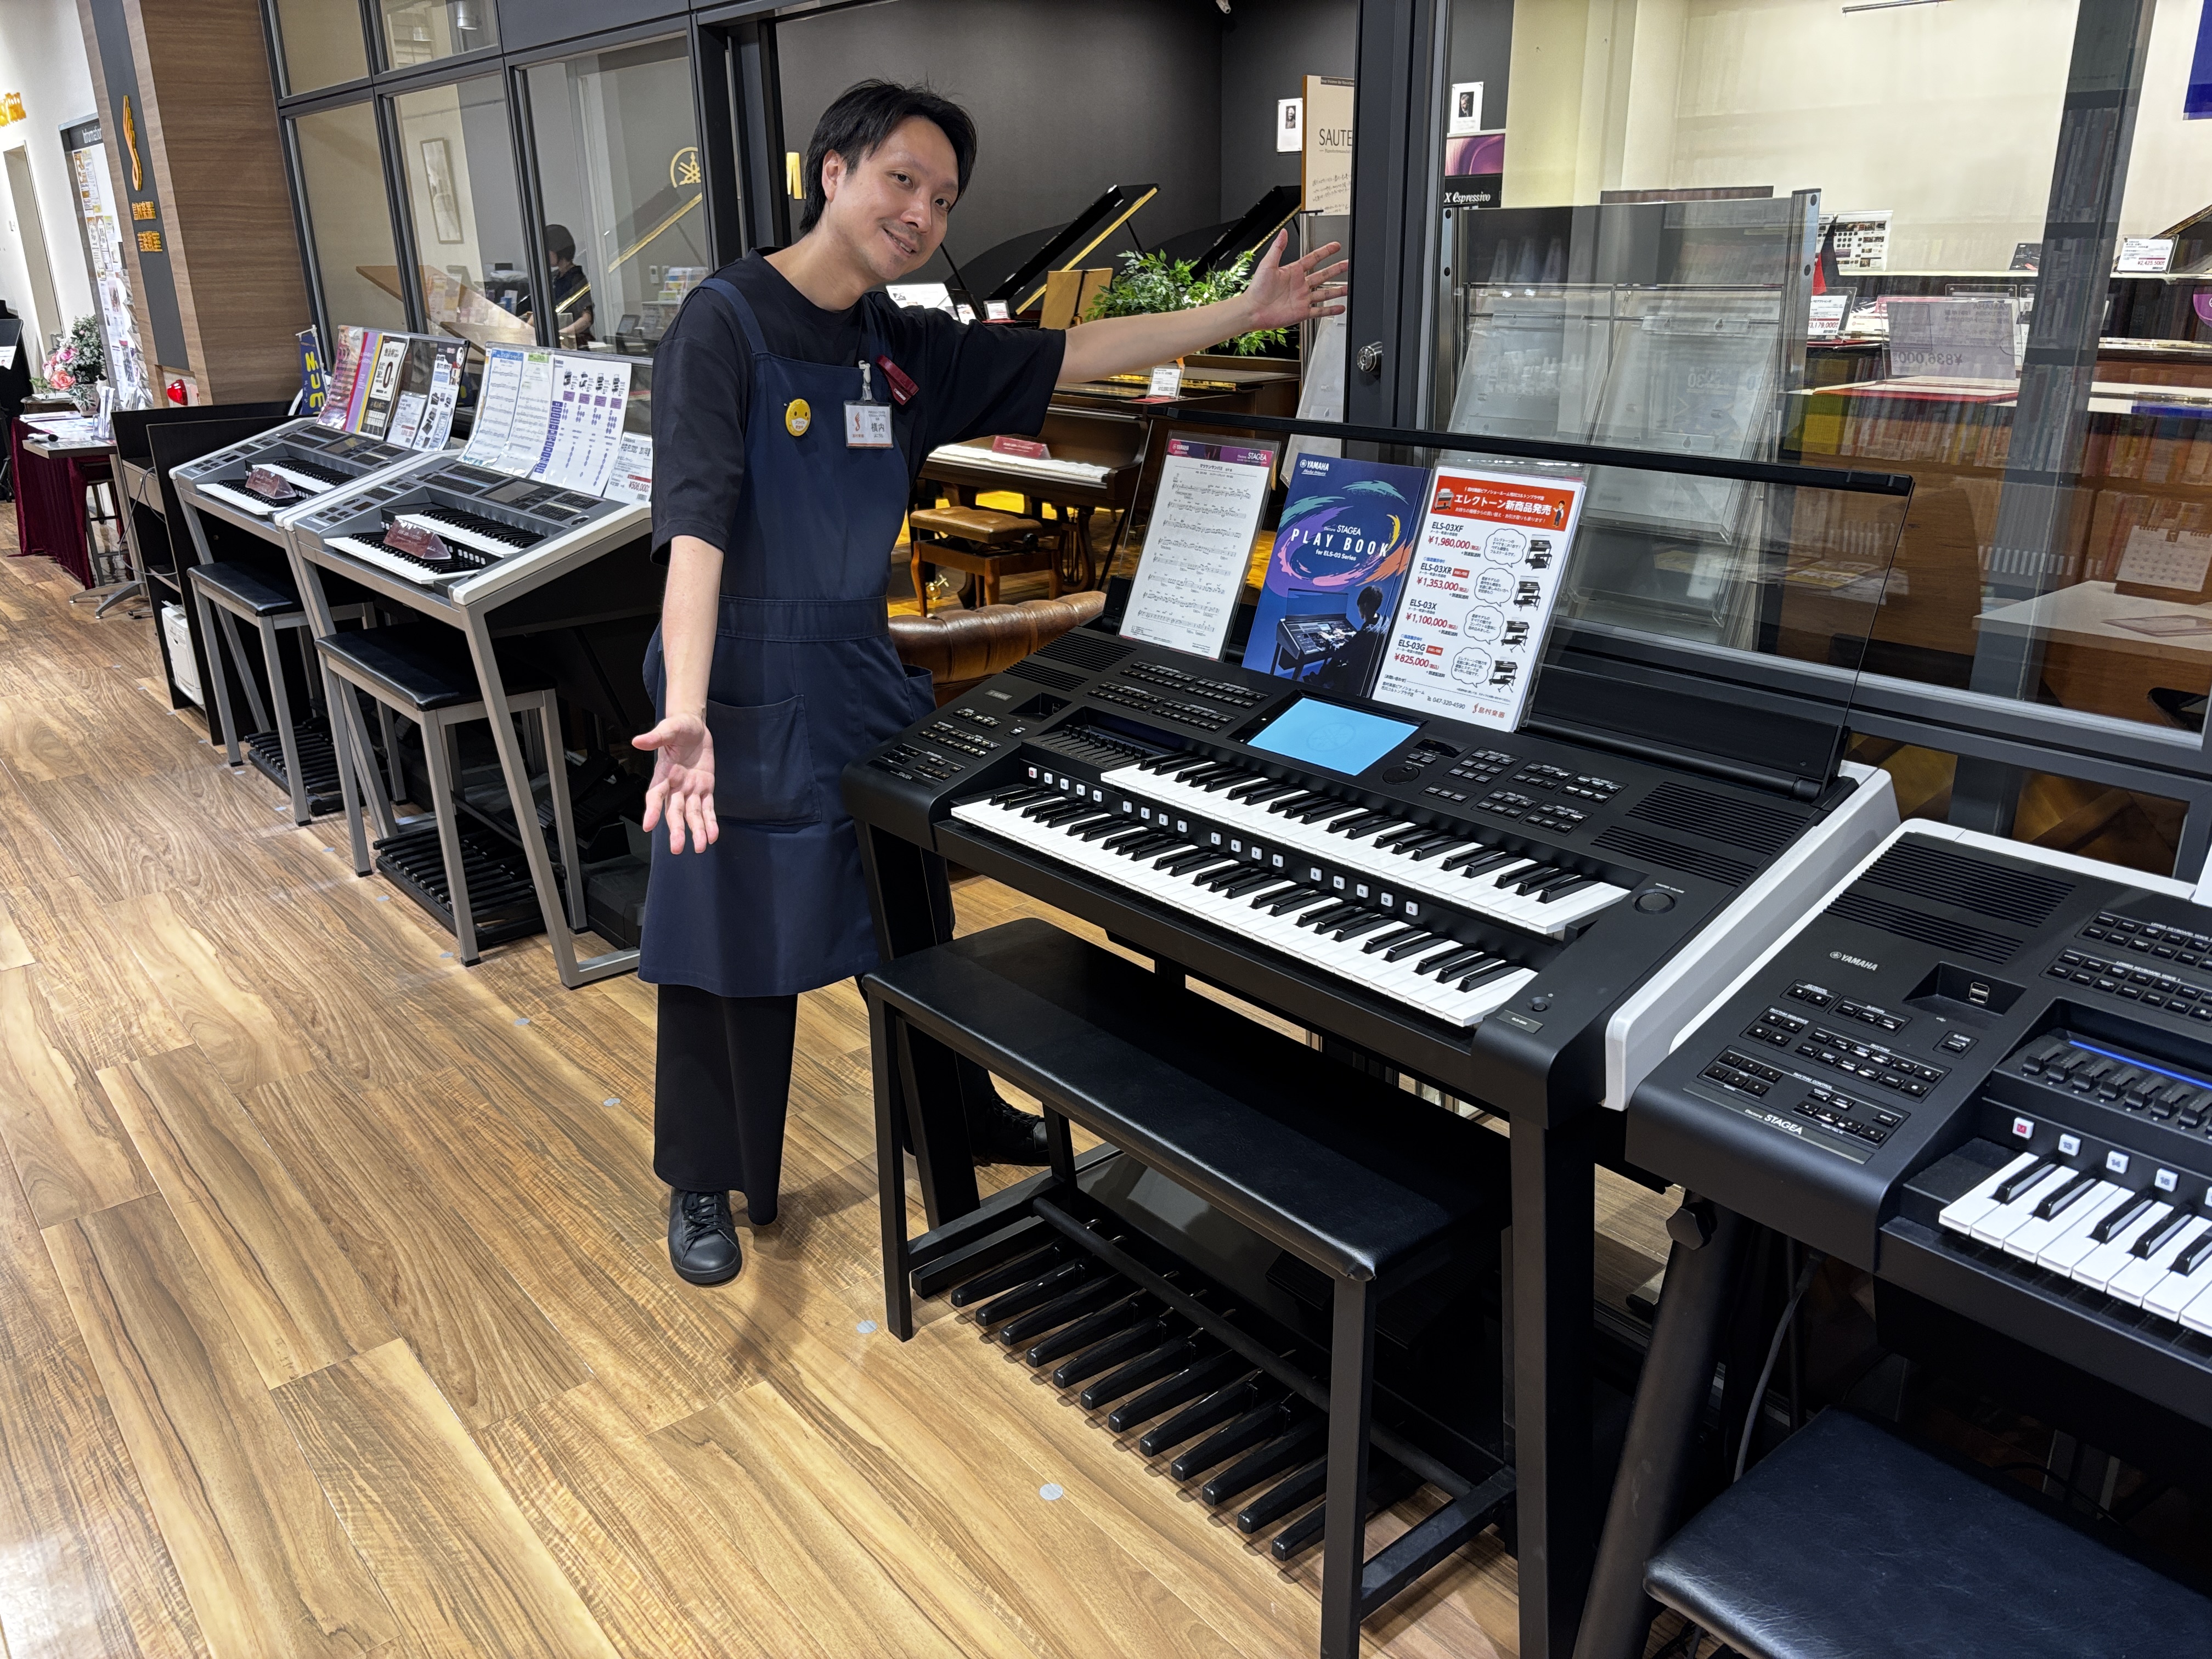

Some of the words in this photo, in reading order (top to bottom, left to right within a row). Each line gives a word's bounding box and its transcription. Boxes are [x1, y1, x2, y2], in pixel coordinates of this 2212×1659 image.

[1247, 452, 1267, 461] STAGEA
[1306, 460, 1329, 471] YAMAHA
[1454, 494, 1553, 516] エレクトーン新商品発売
[1336, 524, 1361, 535] STAGEA
[1431, 521, 1464, 532] ELS-03XF
[1291, 528, 1334, 548] PLAY
[1343, 537, 1389, 557] BOOK
[1428, 535, 1470, 549] ¥1,980,000
[1323, 550, 1341, 558] ELS-03
[1420, 562, 1452, 575] ELS-03XR
[1417, 577, 1459, 591] ¥1,353,000
[1410, 599, 1437, 610] ELS-03X
[1406, 612, 1448, 628] ¥1,100,000
[1398, 639, 1426, 651] ELS-03G
[1394, 652, 1429, 668] ¥825,000
[1432, 697, 1466, 709] 047-320-4590
[1478, 707, 1505, 719] 島村楽器
[1841, 953, 1878, 971] YAMAHA
[1764, 1114, 1803, 1135] STAGEA
[2063, 1141, 2072, 1150] 13
[2111, 1159, 2121, 1168] 14
[2159, 1176, 2170, 1186] 15
